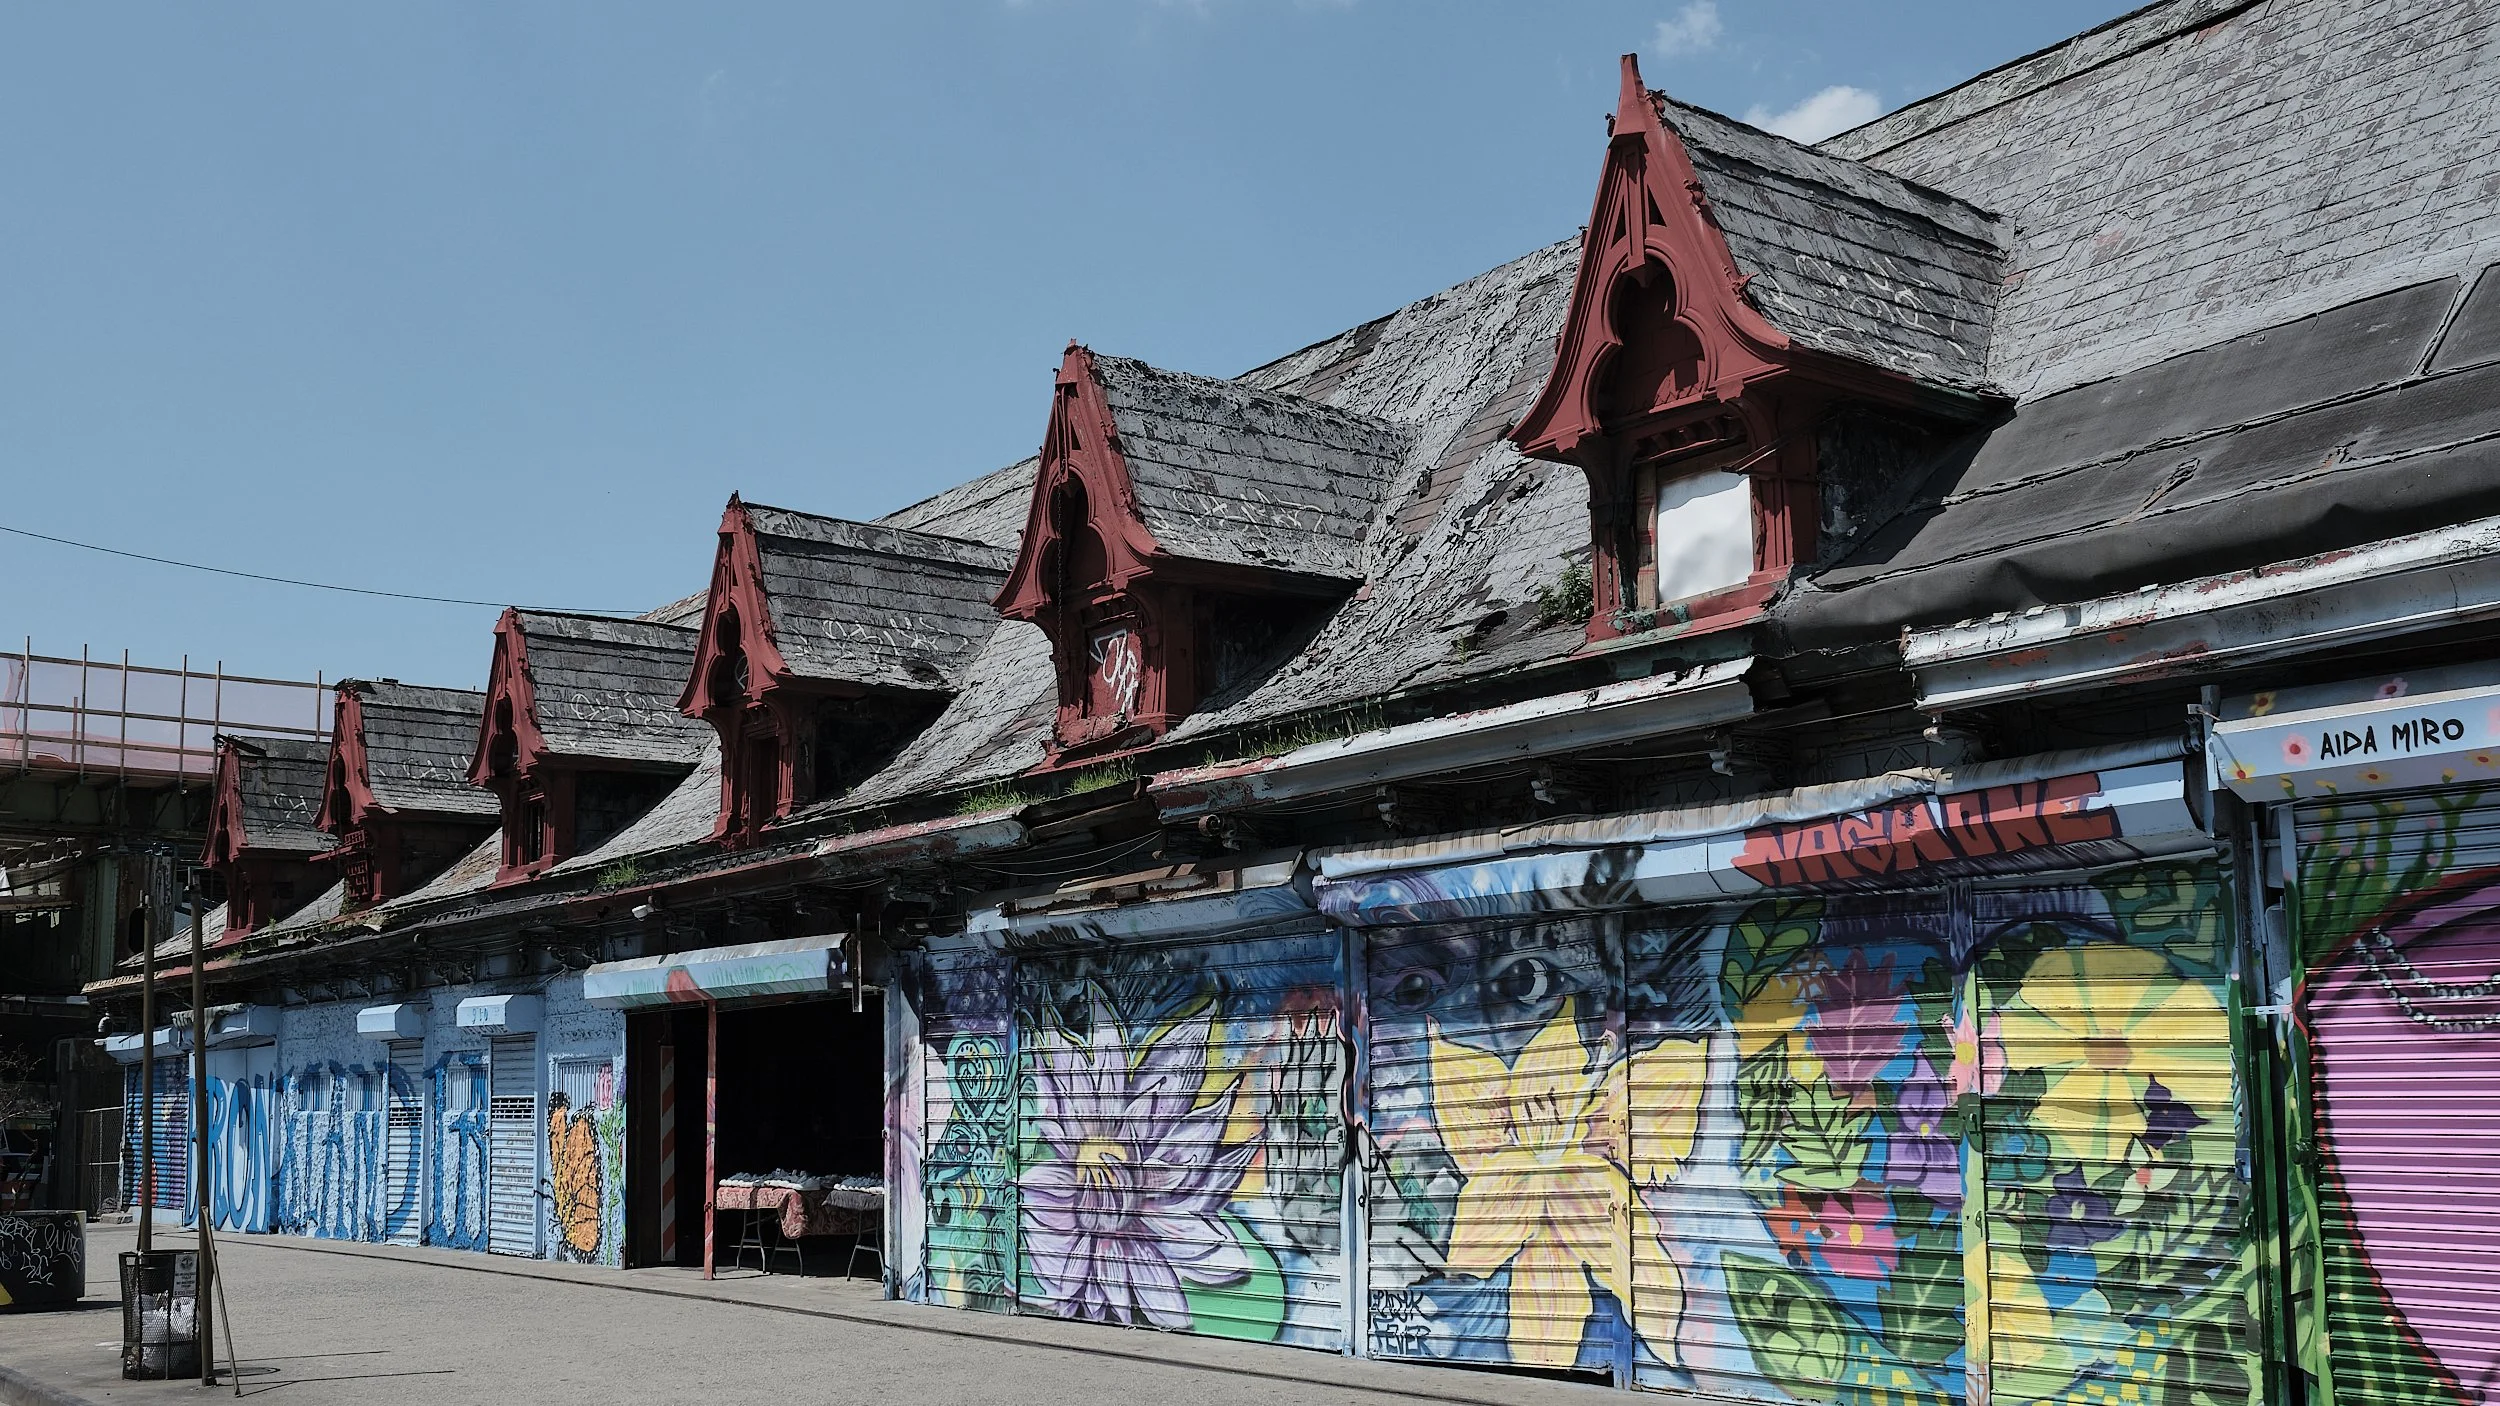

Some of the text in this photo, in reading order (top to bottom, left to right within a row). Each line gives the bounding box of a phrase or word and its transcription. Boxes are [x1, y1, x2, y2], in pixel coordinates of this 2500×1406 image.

[2320, 718, 2464, 760] AIDA MIRO
[1373, 1318, 1433, 1355] FEVER
